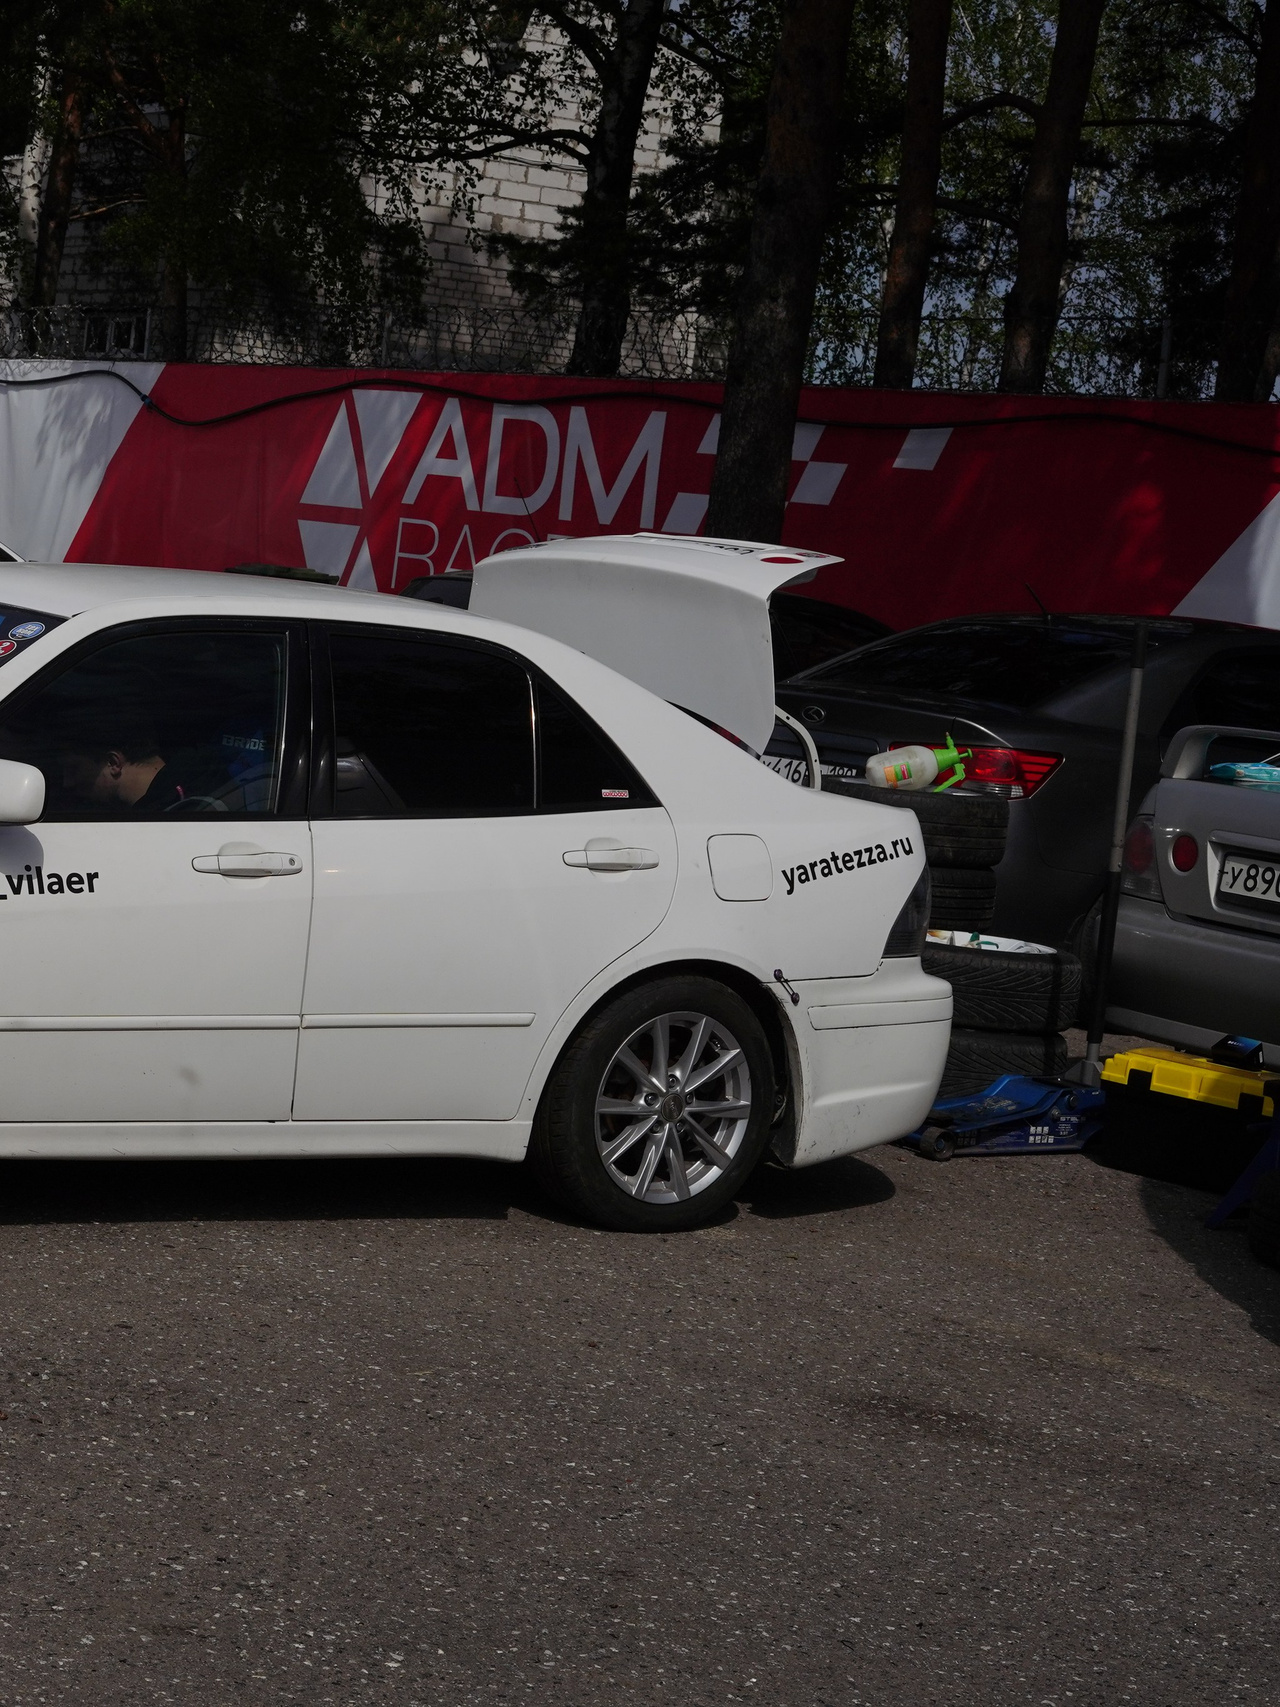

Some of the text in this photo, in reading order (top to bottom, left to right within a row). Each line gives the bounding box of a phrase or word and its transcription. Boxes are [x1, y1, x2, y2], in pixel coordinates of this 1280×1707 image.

[401, 397, 668, 530] ADM
[222, 734, 267, 751] BRIDE
[781, 837, 913, 895] yaratezza.ru
[1229, 863, 1280, 898] У89
